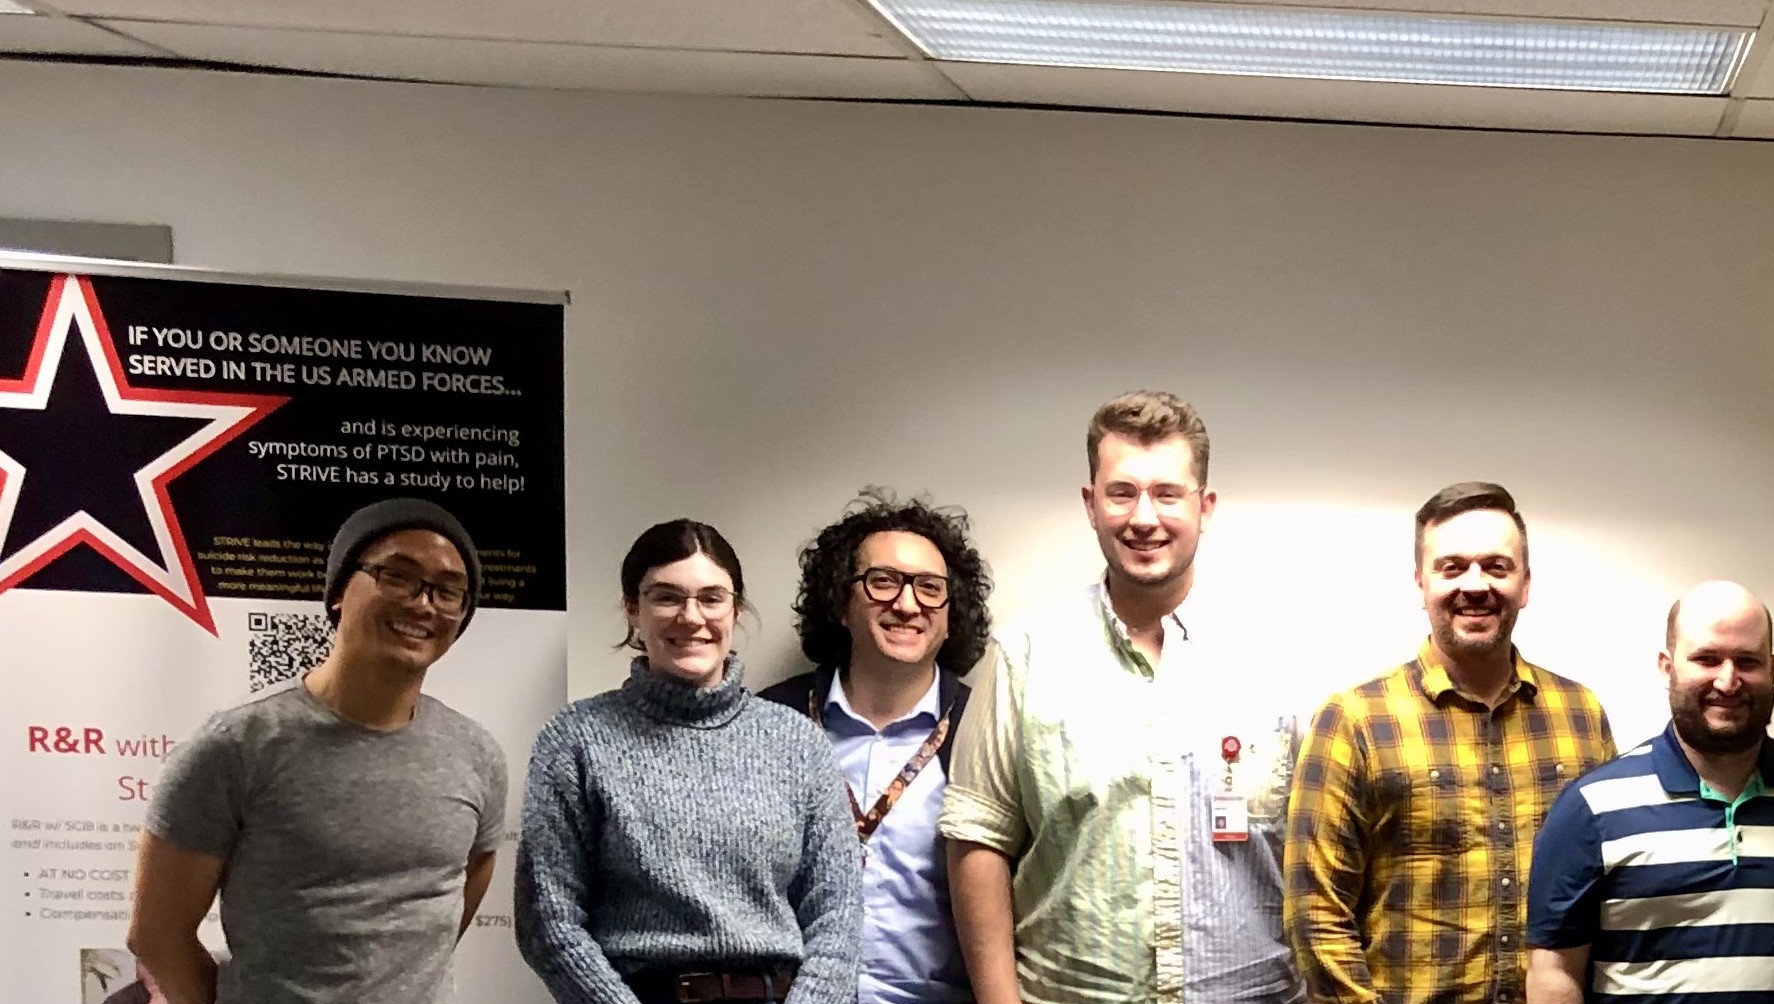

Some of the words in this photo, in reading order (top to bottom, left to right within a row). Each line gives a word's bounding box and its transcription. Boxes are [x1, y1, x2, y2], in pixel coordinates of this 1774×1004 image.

[128, 325, 148, 346] IF
[152, 326, 203, 349] YOU
[209, 331, 243, 352] OR
[248, 333, 362, 359] SOMEONE
[366, 340, 415, 361] YOU
[422, 343, 492, 366] KNOW
[129, 354, 216, 379] SERVED
[222, 360, 246, 381] IN
[251, 361, 296, 384] THE
[301, 364, 332, 386] US
[336, 367, 416, 390] ARMED
[422, 371, 522, 396] FORCES...
[340, 418, 376, 436] and
[381, 419, 396, 437] is
[401, 422, 520, 447] experiencing
[248, 440, 348, 460] symptoms
[353, 443, 373, 460] of
[377, 443, 425, 463] PTSD
[429, 446, 470, 465] with
[475, 449, 520, 469] pain,
[276, 463, 340, 483] STRIVE
[346, 465, 379, 485] has
[383, 470, 395, 485] a
[400, 470, 451, 493] study
[456, 473, 475, 489] to
[480, 473, 525, 495] help!
[213, 536, 251, 548] STRIVE
[282, 539, 301, 550] the
[28, 725, 107, 755] R&R
[11, 818, 42, 831] R&R
[39, 868, 58, 880] AT
[62, 869, 87, 881] NO
[90, 869, 130, 881] COST
[40, 888, 84, 900] Travel
